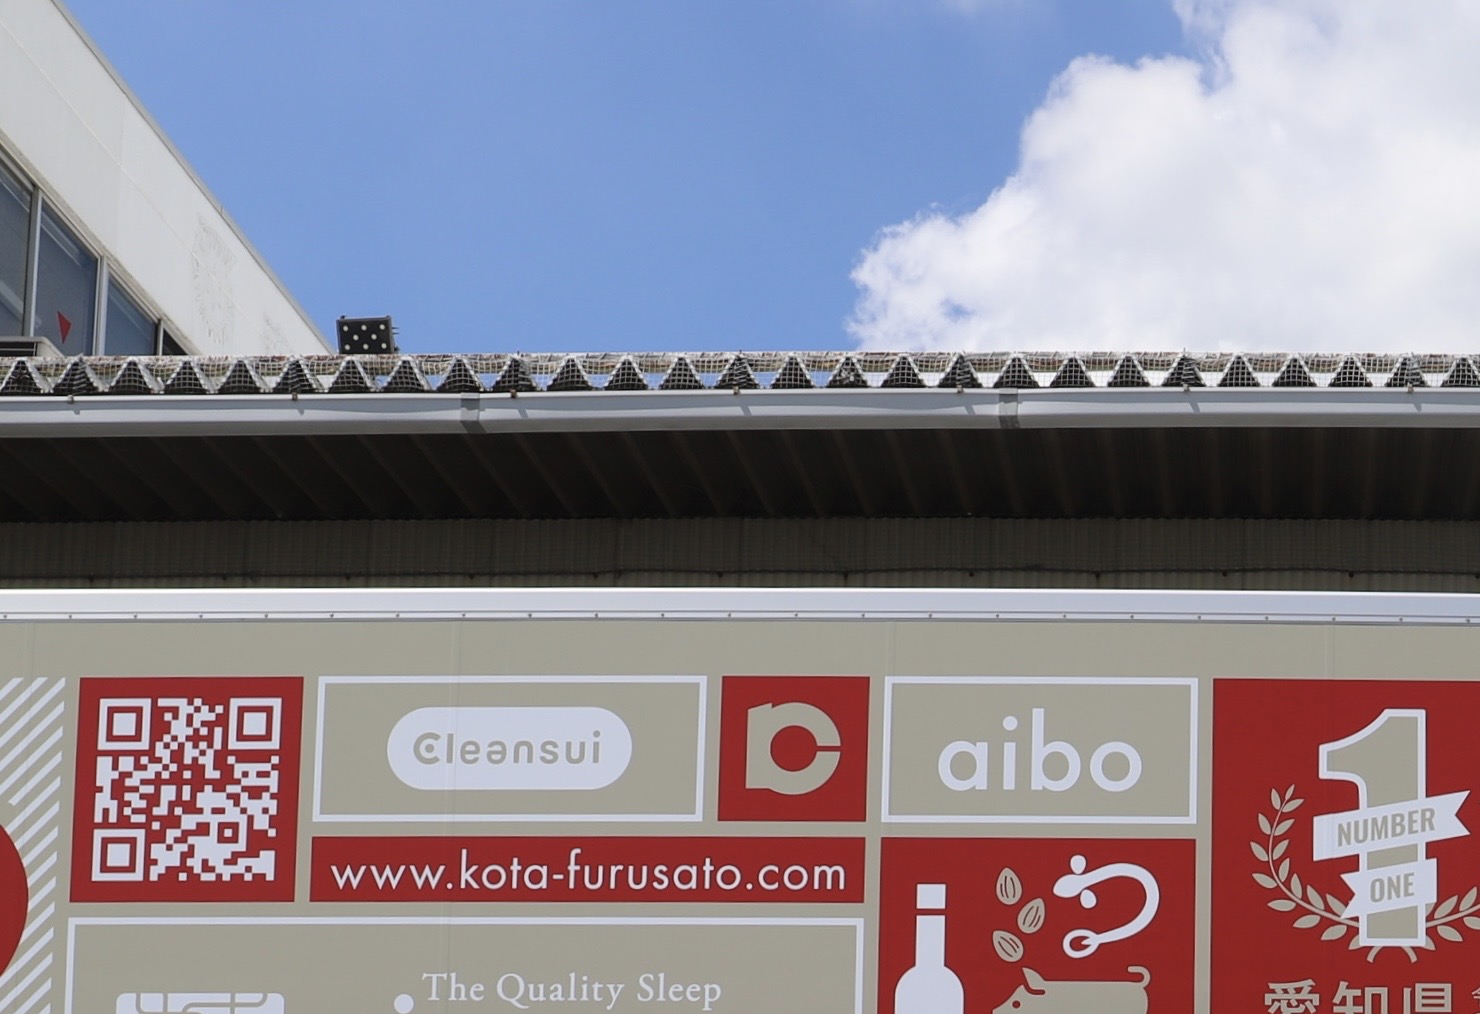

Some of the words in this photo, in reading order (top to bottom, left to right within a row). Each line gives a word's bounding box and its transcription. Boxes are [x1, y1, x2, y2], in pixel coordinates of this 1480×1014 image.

[412, 730, 603, 766] Cleansui
[937, 708, 1143, 792] aibo
[1336, 806, 1437, 849] NUMBER
[330, 848, 846, 892] www.kota-furusato.com
[1369, 872, 1416, 904] ONE
[422, 972, 485, 1003] The
[496, 973, 625, 1010] Quality
[636, 973, 722, 1010] Sleep
